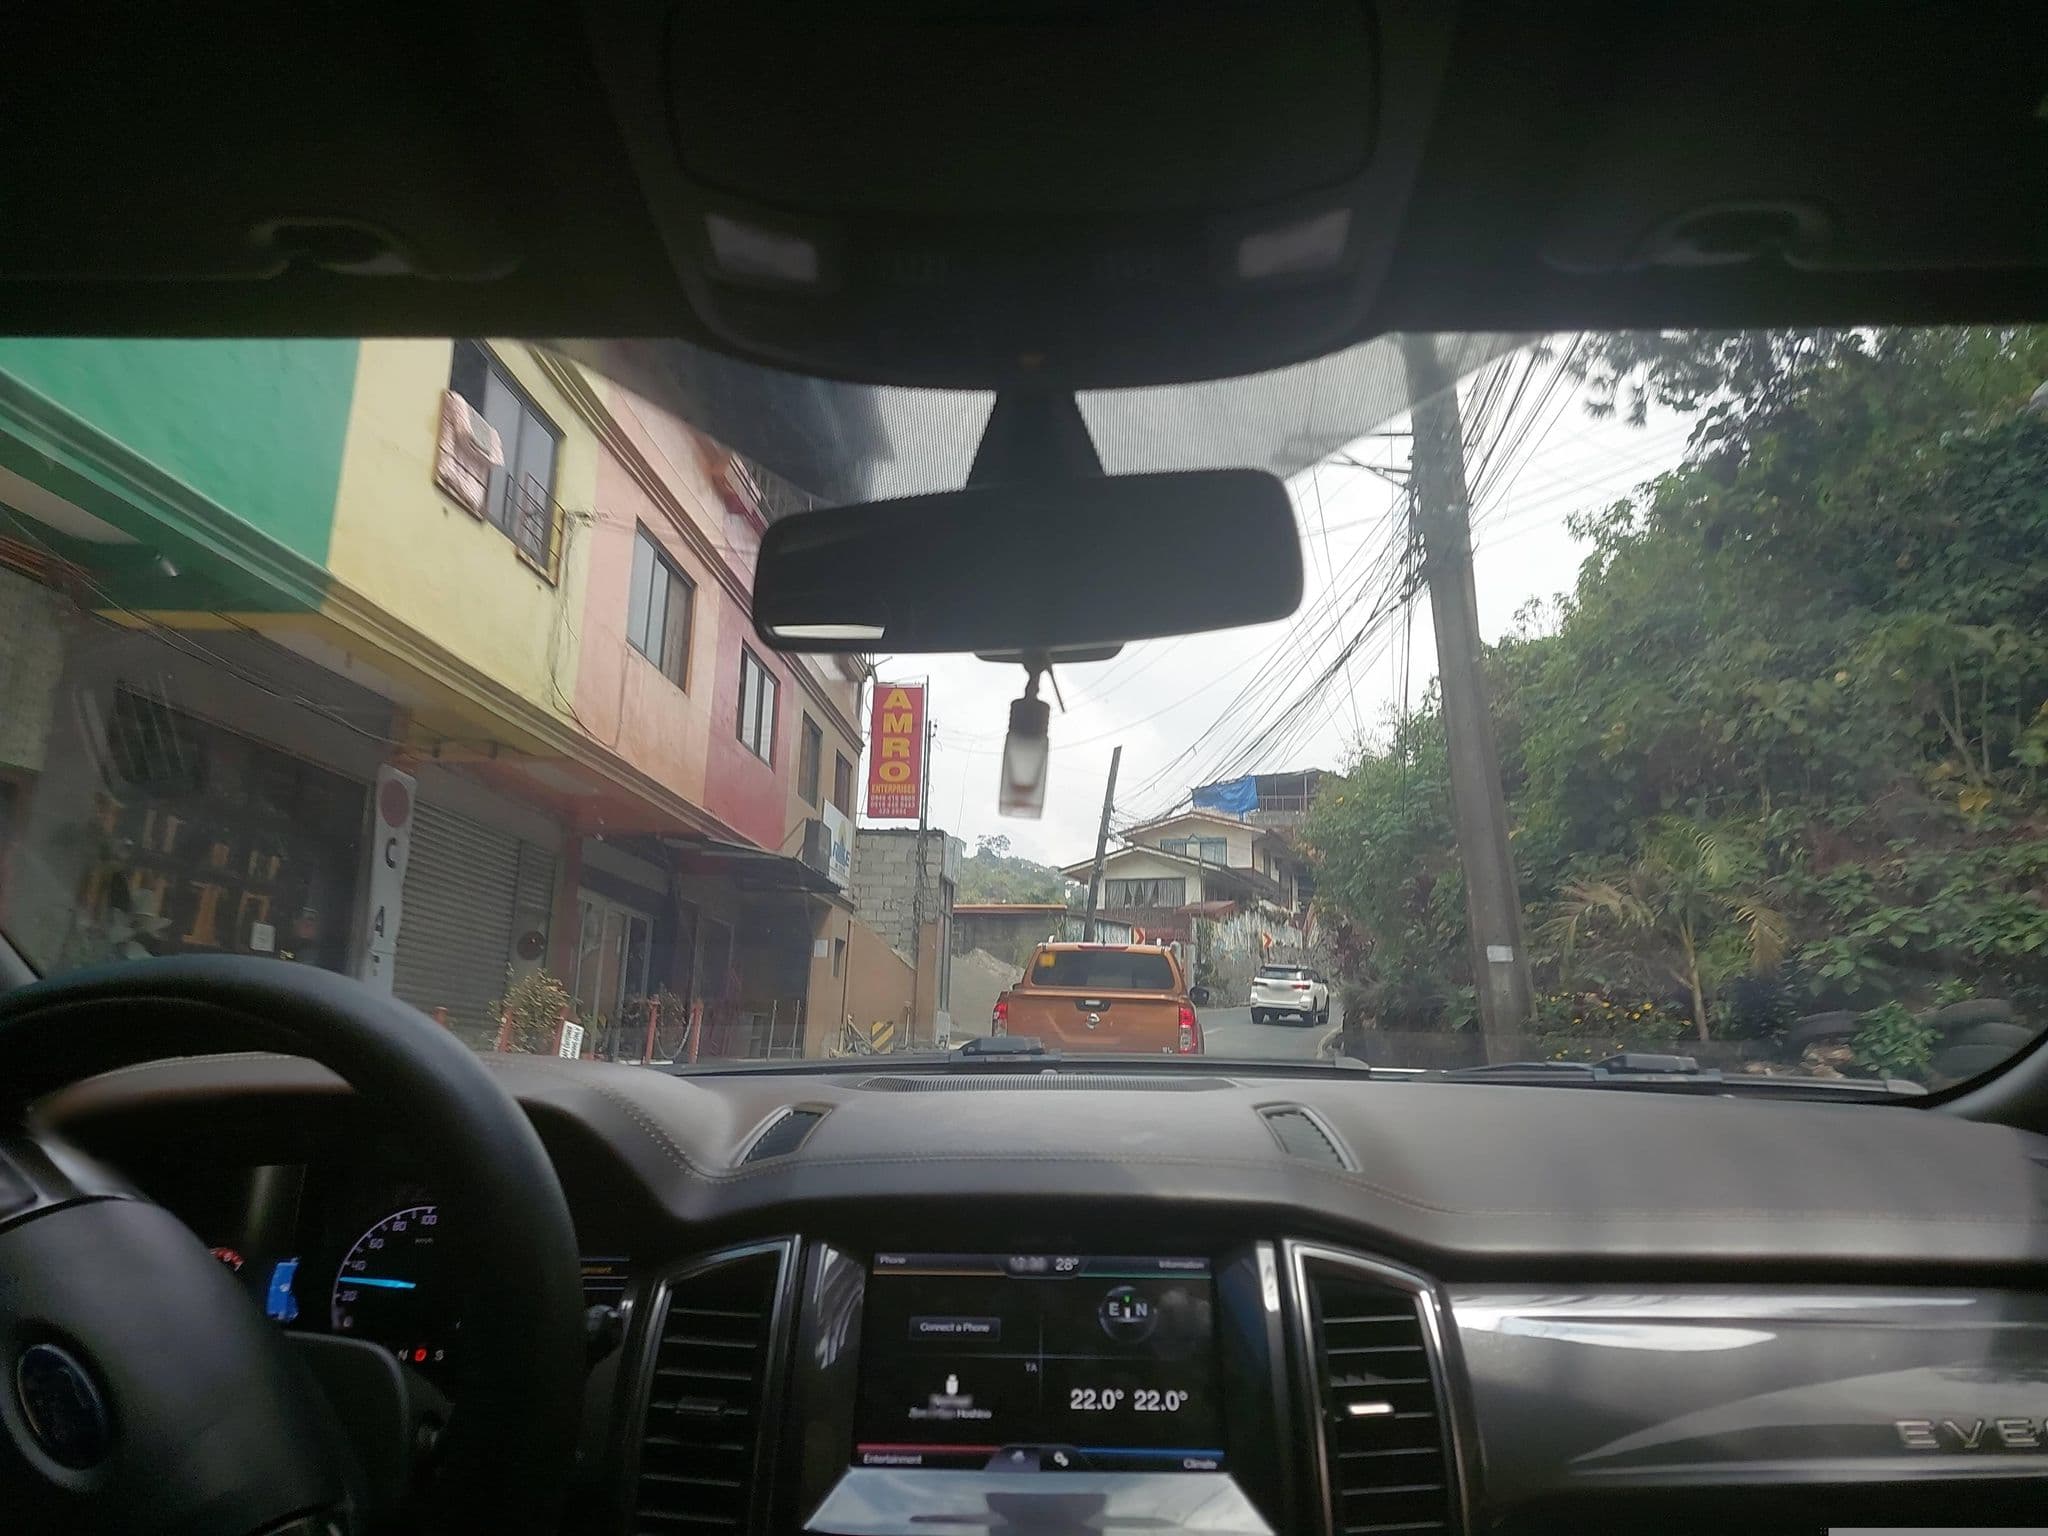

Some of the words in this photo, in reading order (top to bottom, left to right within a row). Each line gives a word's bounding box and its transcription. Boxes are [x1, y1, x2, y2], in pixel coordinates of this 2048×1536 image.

[879, 688, 913, 782] AMRO
[879, 1256, 906, 1266] Phone
[1108, 1303, 1120, 1316] E
[1136, 1303, 1148, 1317] N
[920, 1322, 955, 1333] Connect
[963, 1322, 991, 1333] Phone
[1070, 1388, 1124, 1411] 22.0°
[1134, 1389, 1189, 1412] 22.0°
[1894, 1418, 2048, 1449] EVE
[863, 1453, 922, 1465] Entertainment
